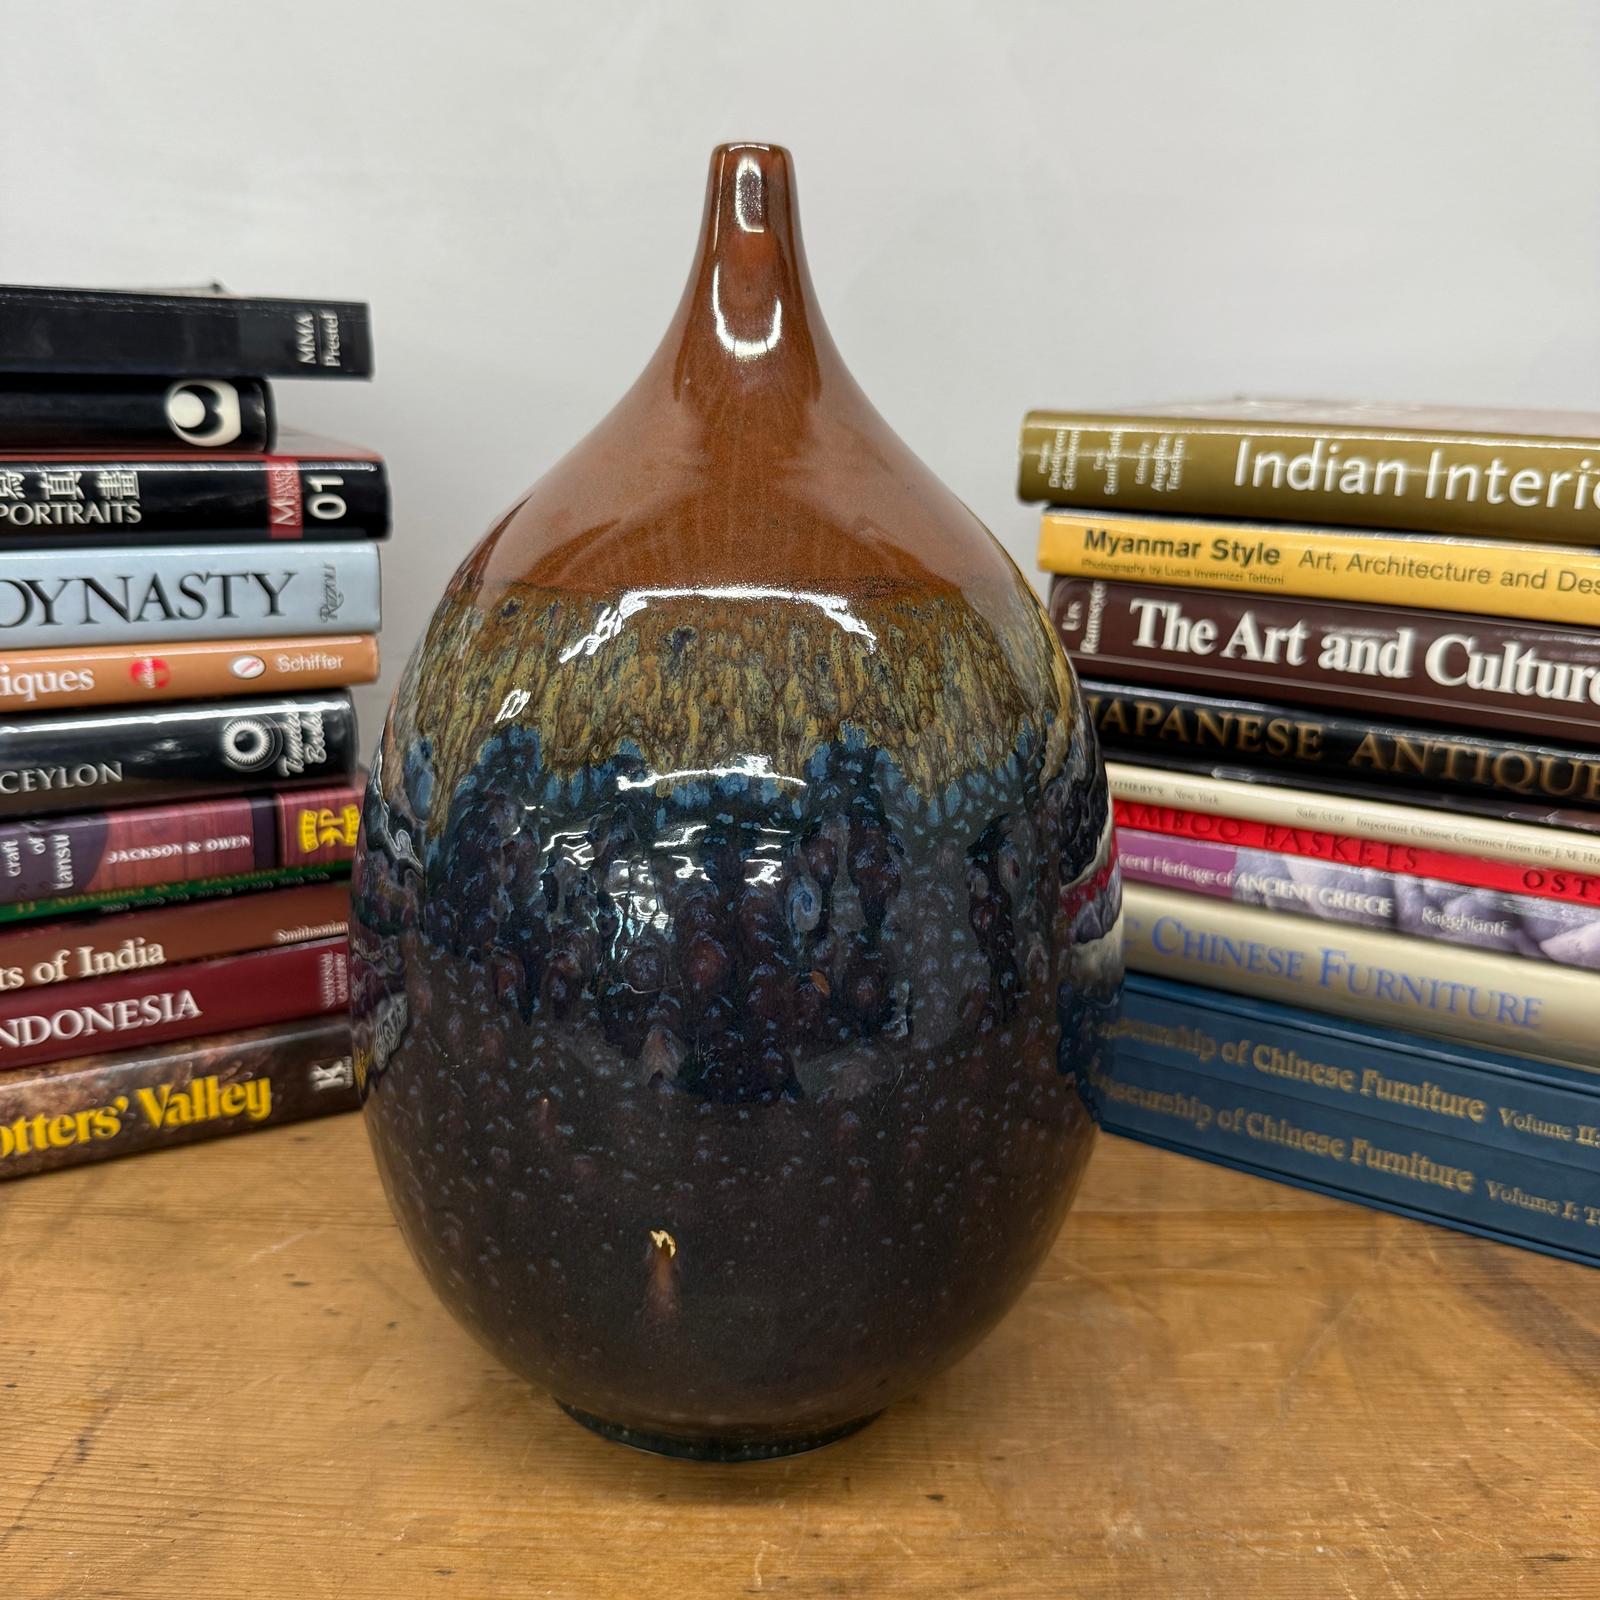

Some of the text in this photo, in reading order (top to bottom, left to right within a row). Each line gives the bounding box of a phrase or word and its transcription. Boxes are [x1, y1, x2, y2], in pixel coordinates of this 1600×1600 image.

[296, 313, 317, 365] MMA
[319, 310, 342, 367] Prestel
[1104, 462, 1118, 495] Sunil
[1151, 435, 1168, 491] Angelika
[1166, 438, 1184, 491] Taschen
[1235, 437, 1600, 510] Indian Interi
[306, 475, 347, 520] 01
[1081, 557, 1145, 576] Photography
[1149, 564, 1161, 577] by
[1165, 565, 1190, 578] Luca
[1084, 529, 1201, 559] Myanmar
[1210, 538, 1281, 567] Style
[1298, 549, 1337, 574] Art,
[1346, 553, 1491, 585] Architecture
[1500, 569, 1547, 591] and
[0, 571, 298, 629] DYNASTY
[277, 653, 345, 673] Schiffer
[1129, 596, 1218, 655] The
[1220, 609, 1311, 667] Art
[1317, 626, 1416, 679] and
[0, 761, 123, 794] CEYLON
[106, 834, 251, 865] JACKSON & OWEN
[1114, 803, 1243, 840] AMBOO
[1264, 824, 1416, 871] BASKETS
[1174, 789, 1194, 801] New
[1356, 817, 1408, 837] Important
[1411, 824, 1451, 841] Chinese
[1454, 831, 1503, 849] Ceramics
[1505, 839, 1530, 853] from
[1534, 843, 1552, 856] the
[1153, 855, 1216, 887] Heritage
[1216, 868, 1233, 888] of
[1234, 870, 1313, 902] ANCIENT
[1319, 886, 1392, 917] GREECE
[276, 920, 348, 944] Smithsonian
[32, 949, 71, 984] of
[77, 937, 167, 977] India
[1152, 915, 1304, 979] CHINESE
[1320, 948, 1543, 1029] FURNITURE
[136, 1075, 272, 1129] Valley
[1221, 1040, 1250, 1065] of
[1253, 1044, 1355, 1090] Chinese
[1360, 1069, 1488, 1124] Furniture
[1498, 1106, 1573, 1142] Volume
[1217, 1107, 1245, 1134] of
[1245, 1112, 1346, 1161] Chinese
[1351, 1136, 1475, 1194] Furniture
[1485, 1179, 1559, 1216] Volume
